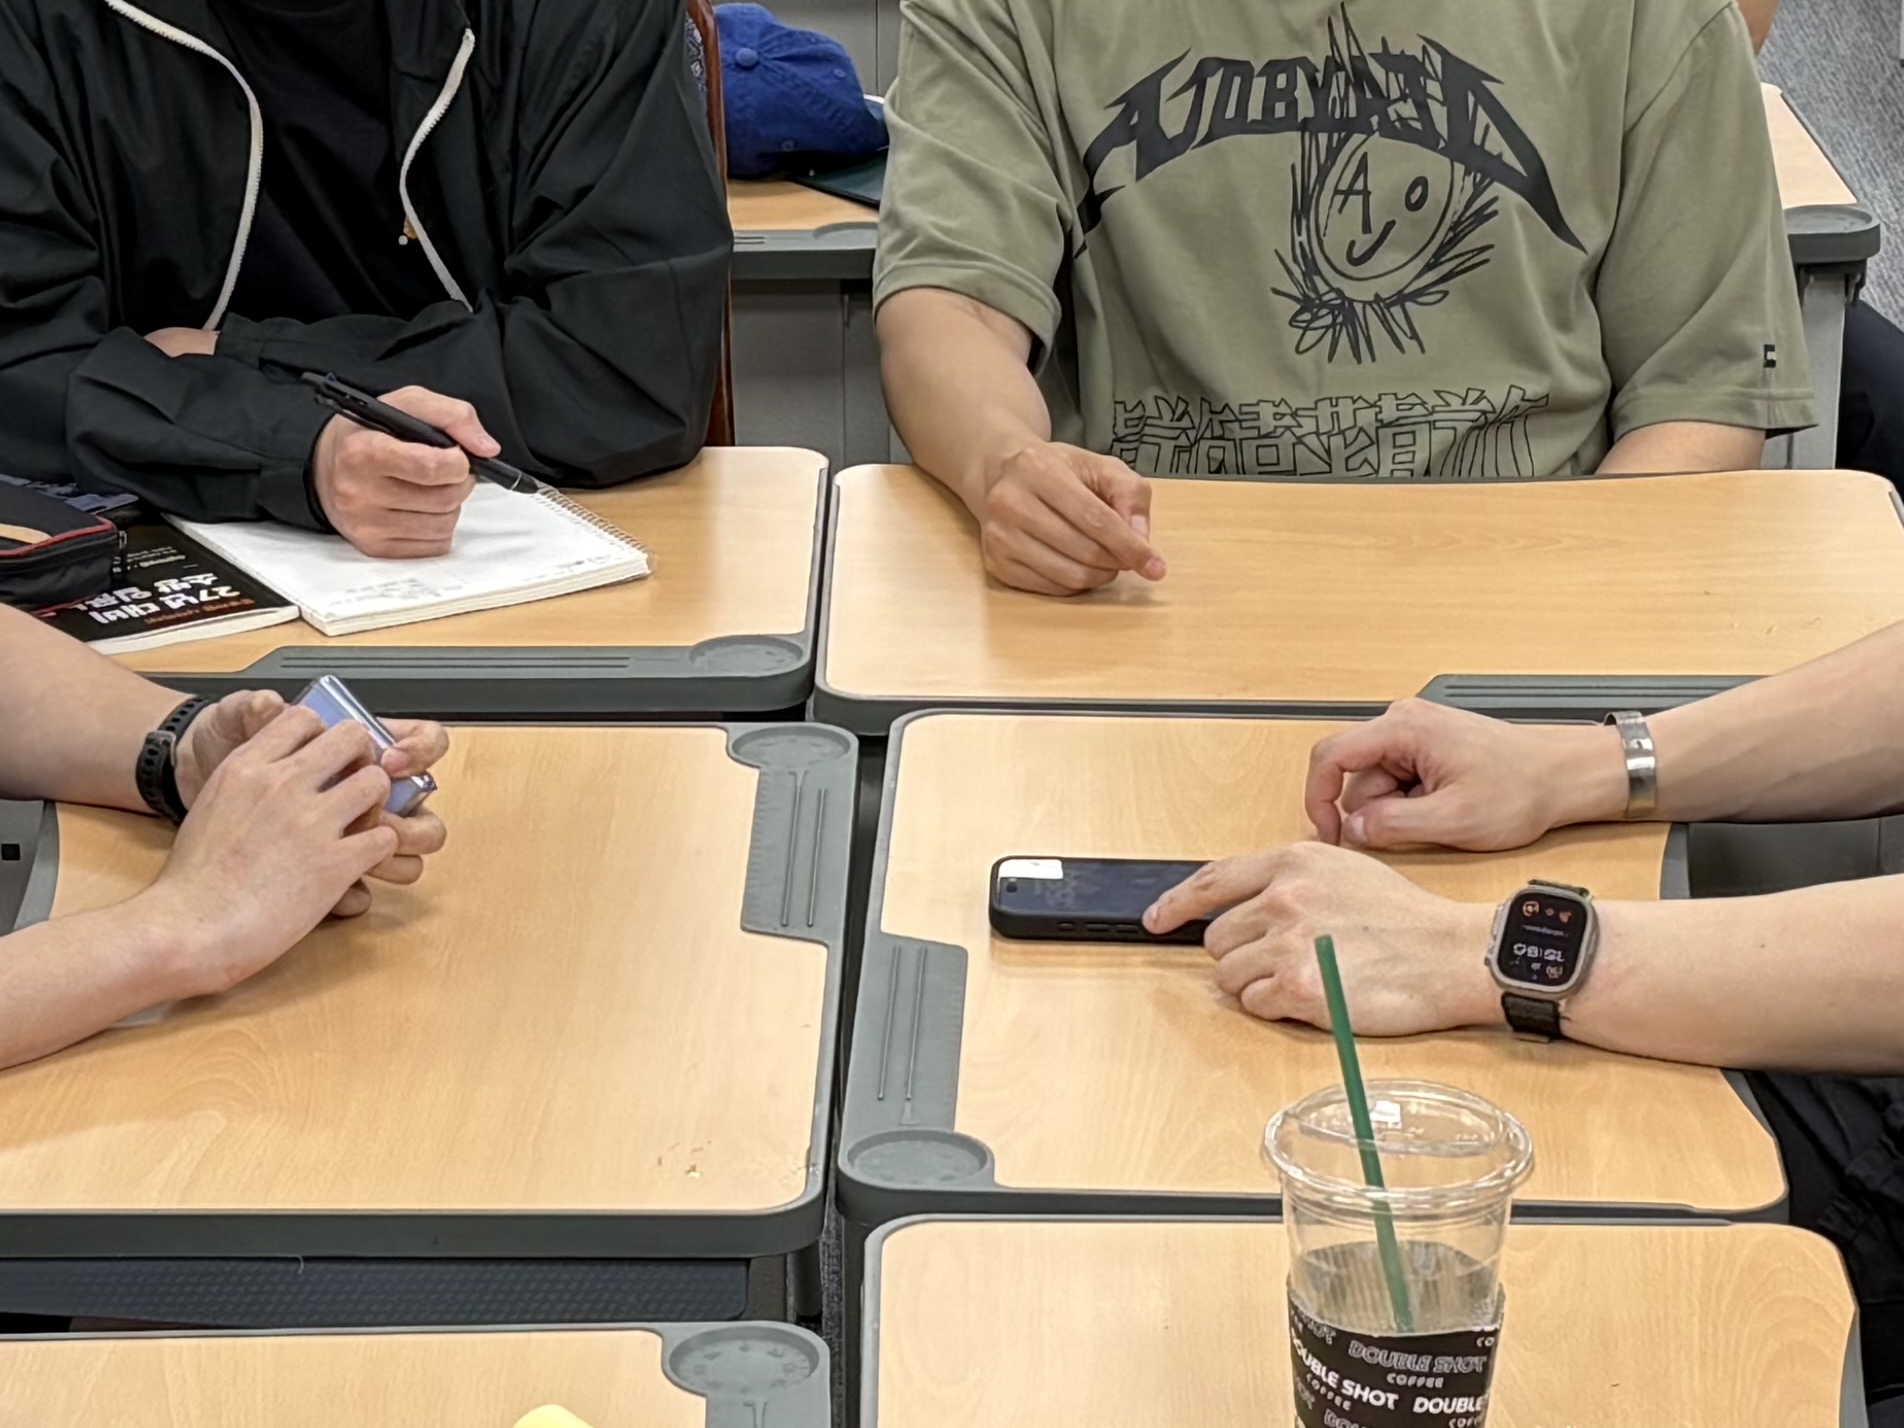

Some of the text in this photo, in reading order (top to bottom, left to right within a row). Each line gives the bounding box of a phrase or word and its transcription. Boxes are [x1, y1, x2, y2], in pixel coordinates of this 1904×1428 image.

[159, 585, 241, 610] 27년
[89, 602, 161, 625] 대비
[1348, 1339, 1488, 1374] DOUBLE SHOT
[1386, 1372, 1445, 1389] COFFEE
[1341, 1379, 1400, 1411] SHOT
